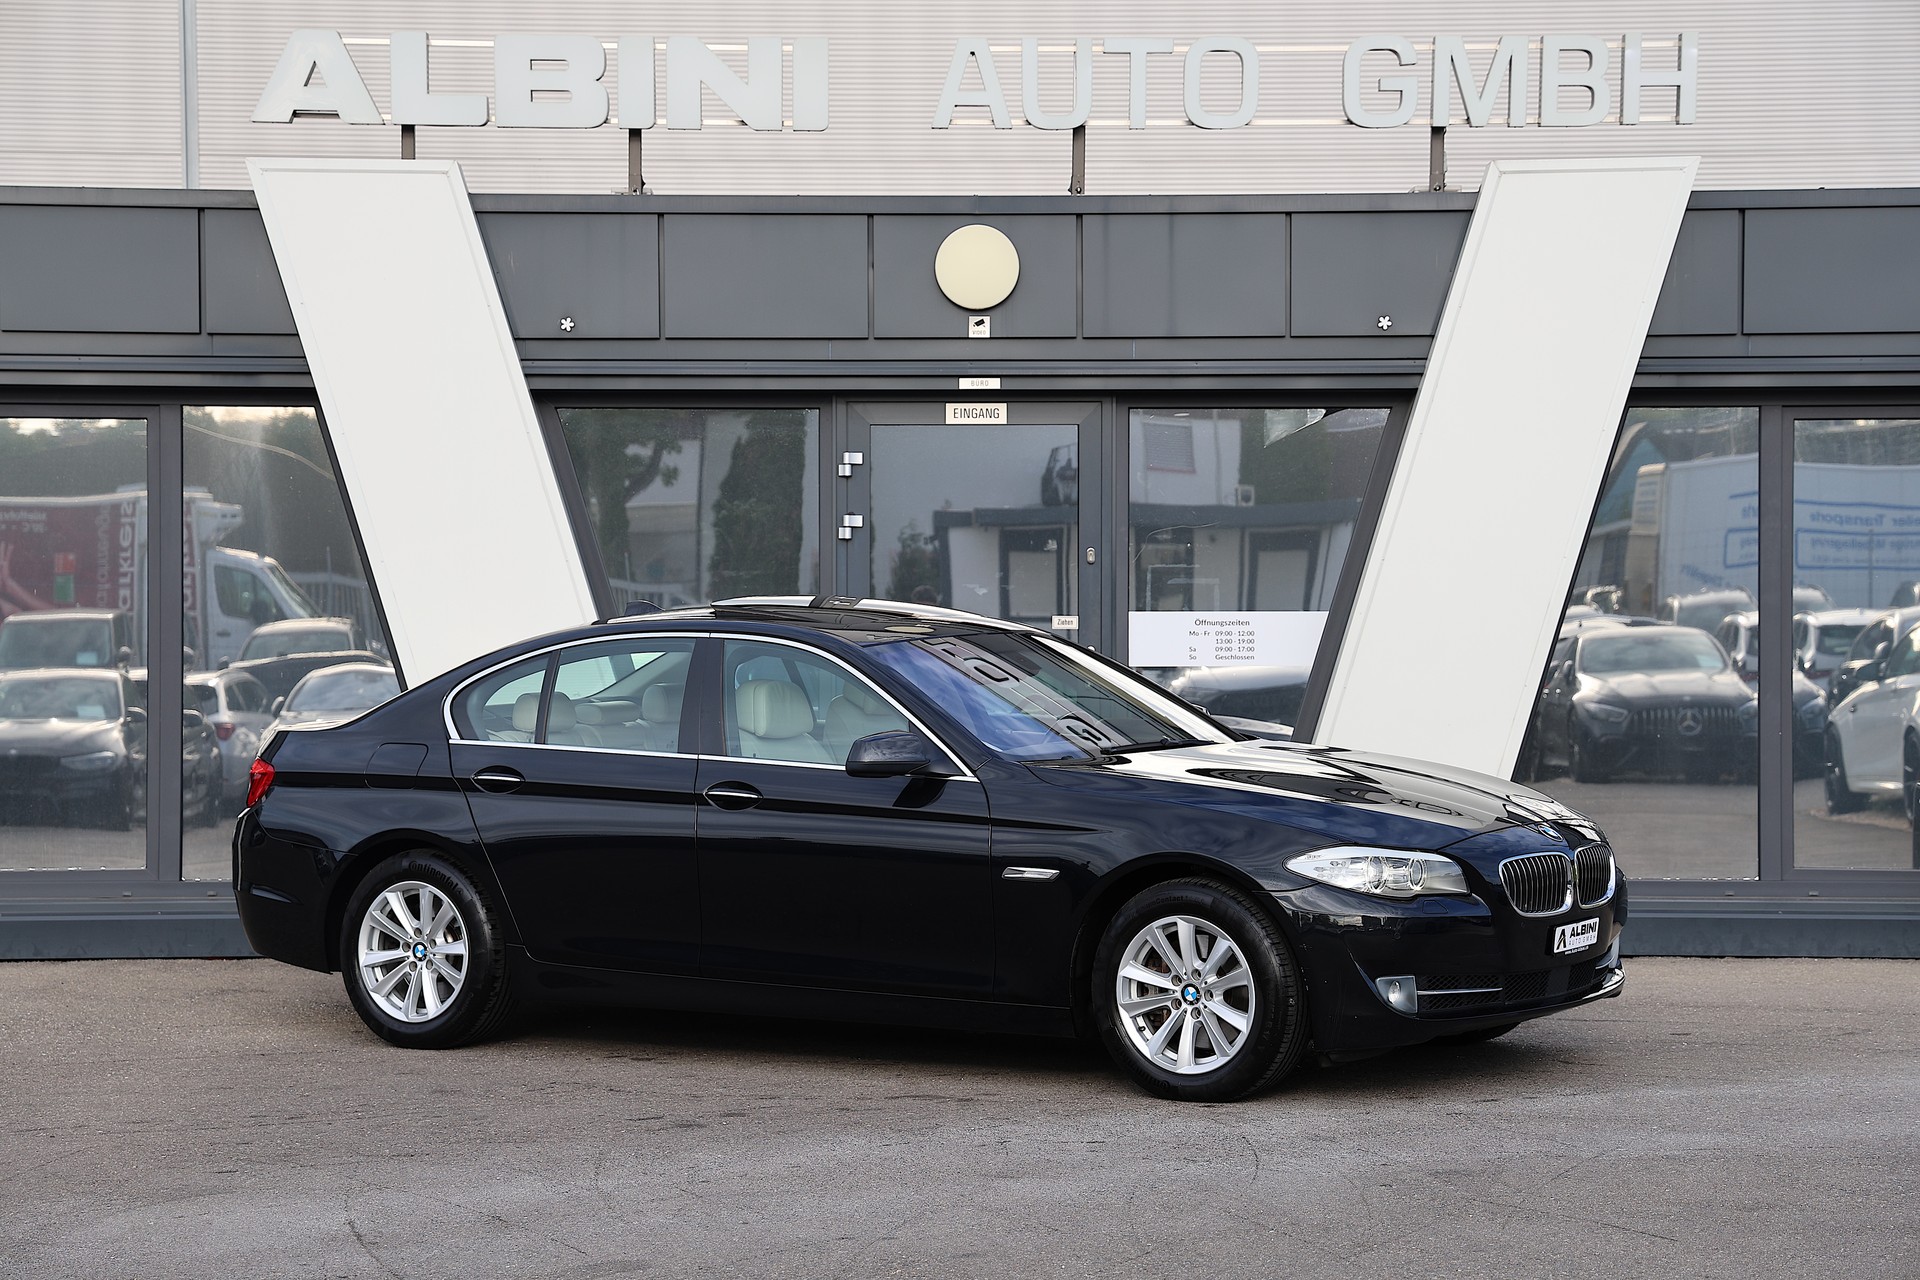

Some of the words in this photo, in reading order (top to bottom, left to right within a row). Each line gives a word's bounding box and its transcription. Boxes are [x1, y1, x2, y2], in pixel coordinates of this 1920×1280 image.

[251, 29, 829, 132] ALBINI
[931, 36, 1260, 130] AUTO
[1342, 30, 1700, 128] GMBH
[971, 379, 989, 387] BÜRO
[953, 407, 1000, 419] EINGANG
[1194, 618, 1250, 627] Öffnungszeiten
[1569, 921, 1597, 938] ALBINI
